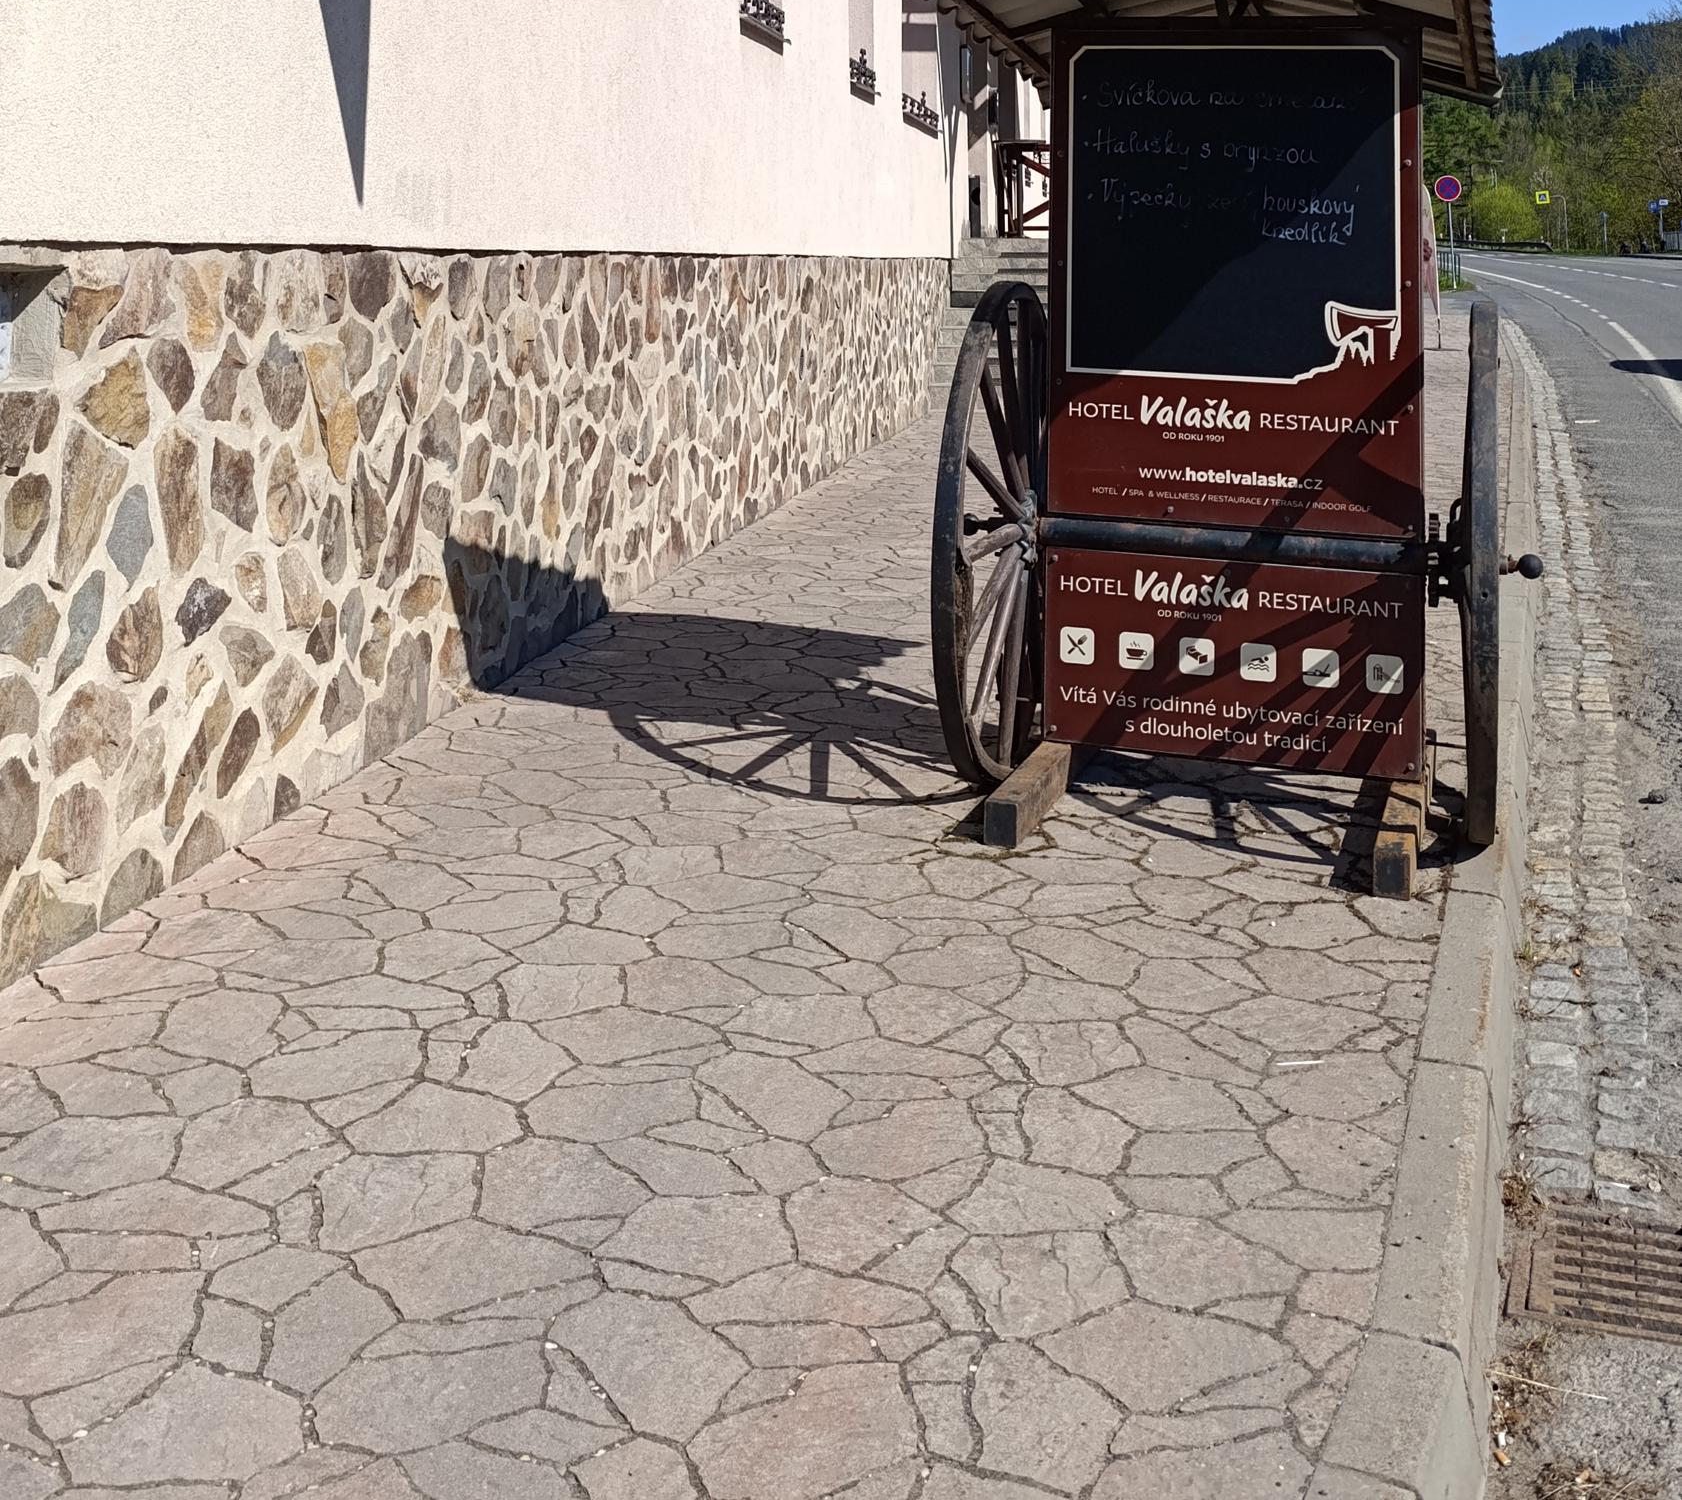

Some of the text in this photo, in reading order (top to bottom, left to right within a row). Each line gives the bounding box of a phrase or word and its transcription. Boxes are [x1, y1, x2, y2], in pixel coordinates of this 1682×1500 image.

[1199, 141, 1212, 159] s
[1068, 394, 1400, 436] HOTEL Valaška RESTAURANT
[1162, 431, 1225, 443] OD ROKU 1901
[1138, 466, 1324, 491] www.hotelvalaska.cz
[1092, 486, 1119, 496] HOTEL
[1128, 488, 1145, 498] SPA
[1147, 489, 1154, 498] &
[1155, 490, 1200, 502] WELLNESS
[1207, 494, 1263, 506] RESTAURACE
[1271, 498, 1304, 509] TERASA
[1312, 501, 1347, 512] INDOOR
[1348, 503, 1372, 513] GOLF
[1060, 569, 1404, 619] HOTEL Valaška RESTAURANT
[1157, 609, 1223, 622] OD ROKU 1901
[1059, 685, 1404, 736] Vítá Vás rodinné ubytovací zařízení
[1125, 718, 1333, 754] s dlouholetou tradicí.
